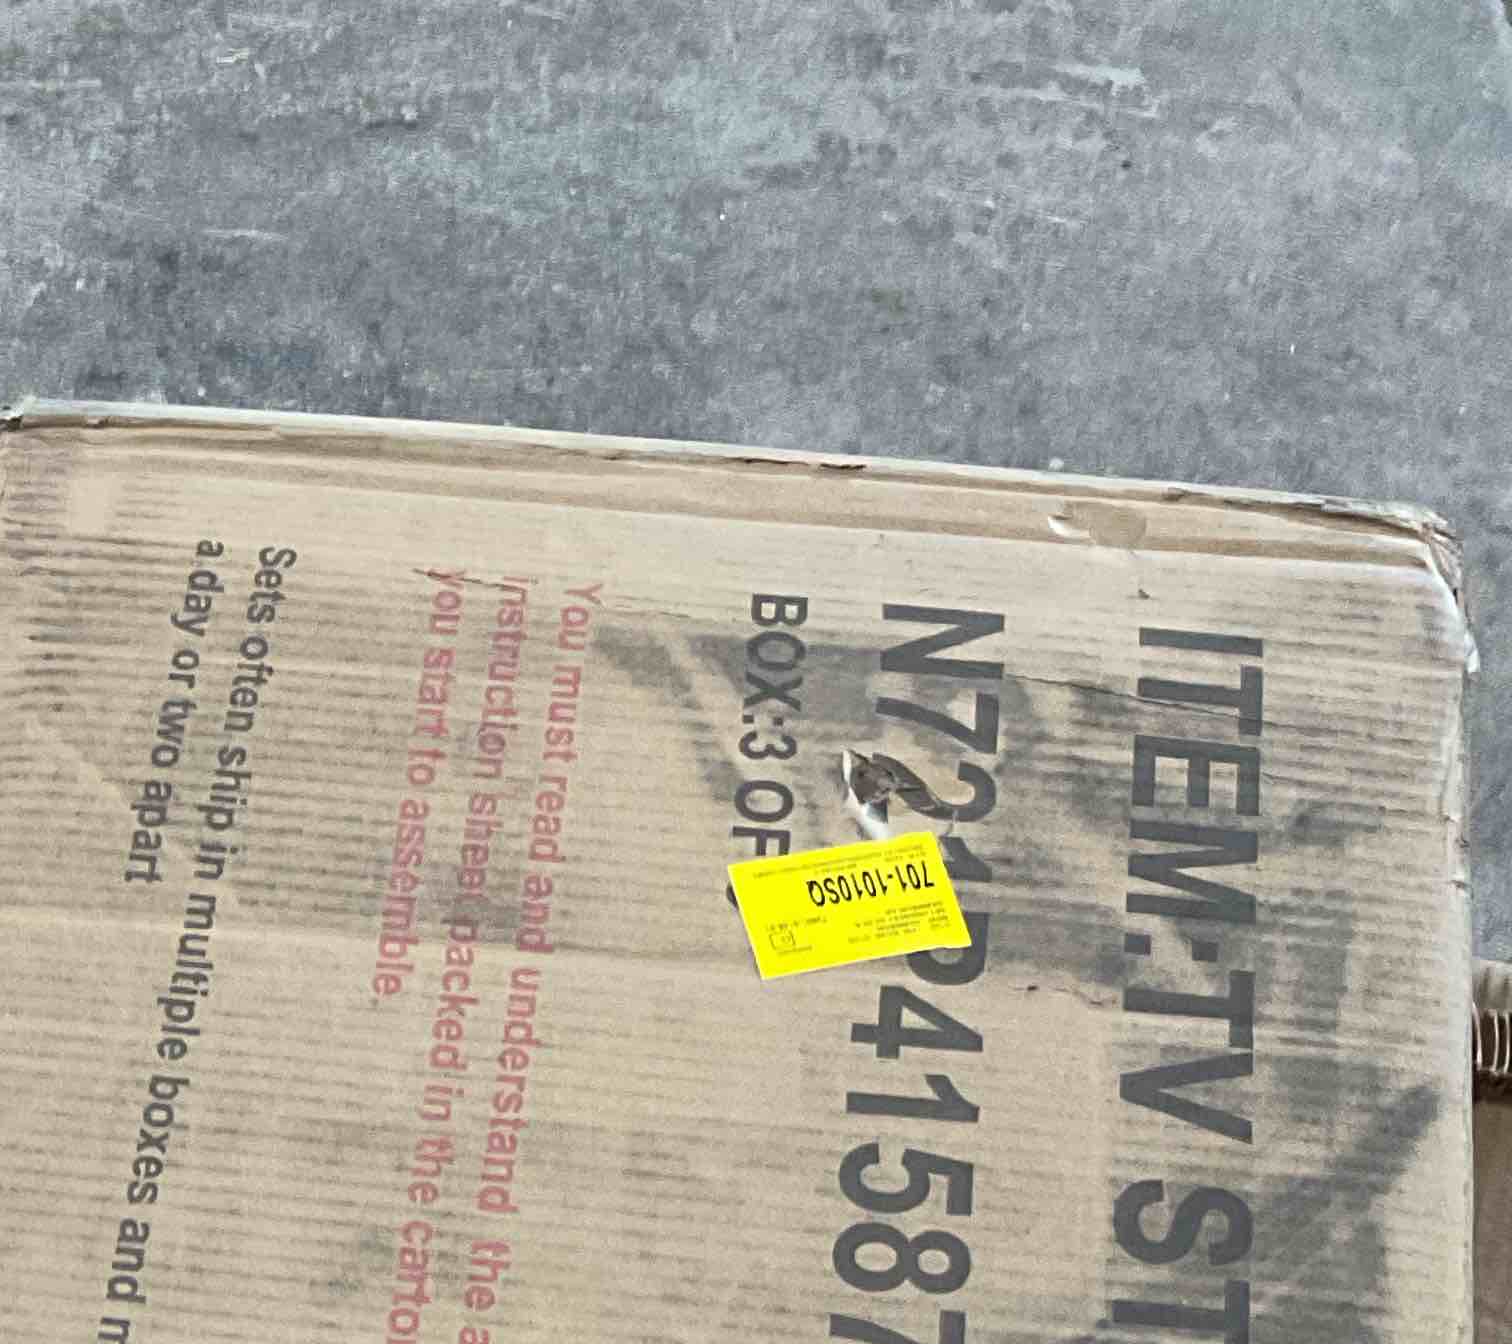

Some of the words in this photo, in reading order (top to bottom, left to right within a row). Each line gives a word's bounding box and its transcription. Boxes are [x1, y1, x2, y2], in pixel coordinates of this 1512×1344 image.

[196, 540, 224, 558] a
[246, 546, 297, 624] Sets
[171, 570, 224, 637] day
[558, 583, 604, 651] You
[169, 650, 200, 689] or
[225, 636, 274, 733] often
[416, 649, 456, 736] start
[472, 575, 537, 779] instruction
[152, 701, 196, 768] two
[544, 666, 581, 762] must
[197, 746, 252, 830] ship
[407, 749, 446, 785] to
[125, 780, 172, 884] apart
[457, 791, 503, 897] sheet
[529, 776, 568, 863] read
[733, 780, 794, 856] OF
[193, 839, 238, 880] in
[806, 861, 934, 906] 701-1010SQ
[518, 873, 554, 954] and
[157, 893, 216, 1061] multiple
[430, 915, 479, 1070] packed
[419, 1084, 463, 1122] in
[476, 967, 543, 1213] understand
[127, 1074, 190, 1205] boxes
[407, 1136, 454, 1205] the
[106, 1218, 150, 1304] and
[463, 1240, 511, 1312] the
